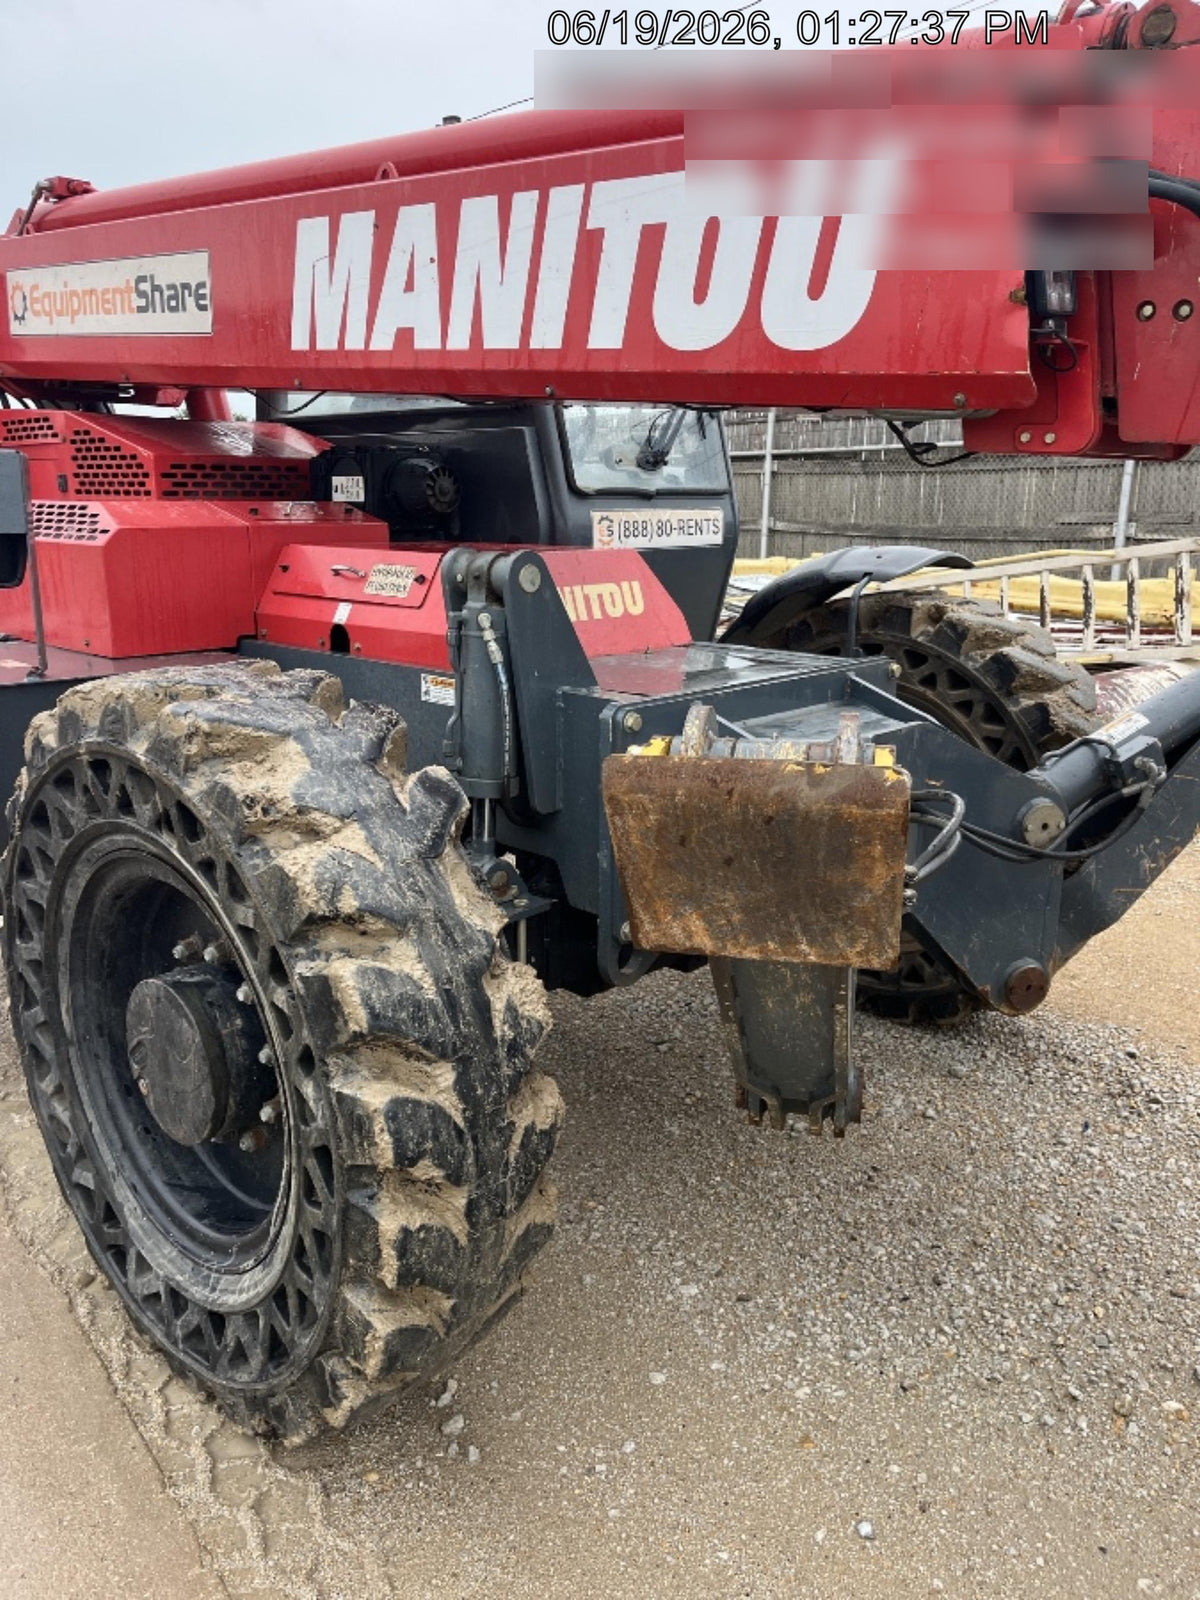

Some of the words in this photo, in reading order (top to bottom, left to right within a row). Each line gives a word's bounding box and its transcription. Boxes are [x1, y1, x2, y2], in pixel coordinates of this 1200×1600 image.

[290, 150, 900, 352] MANITOU
[29, 273, 209, 325] EquipmentShare
[556, 581, 645, 622] NITOU
